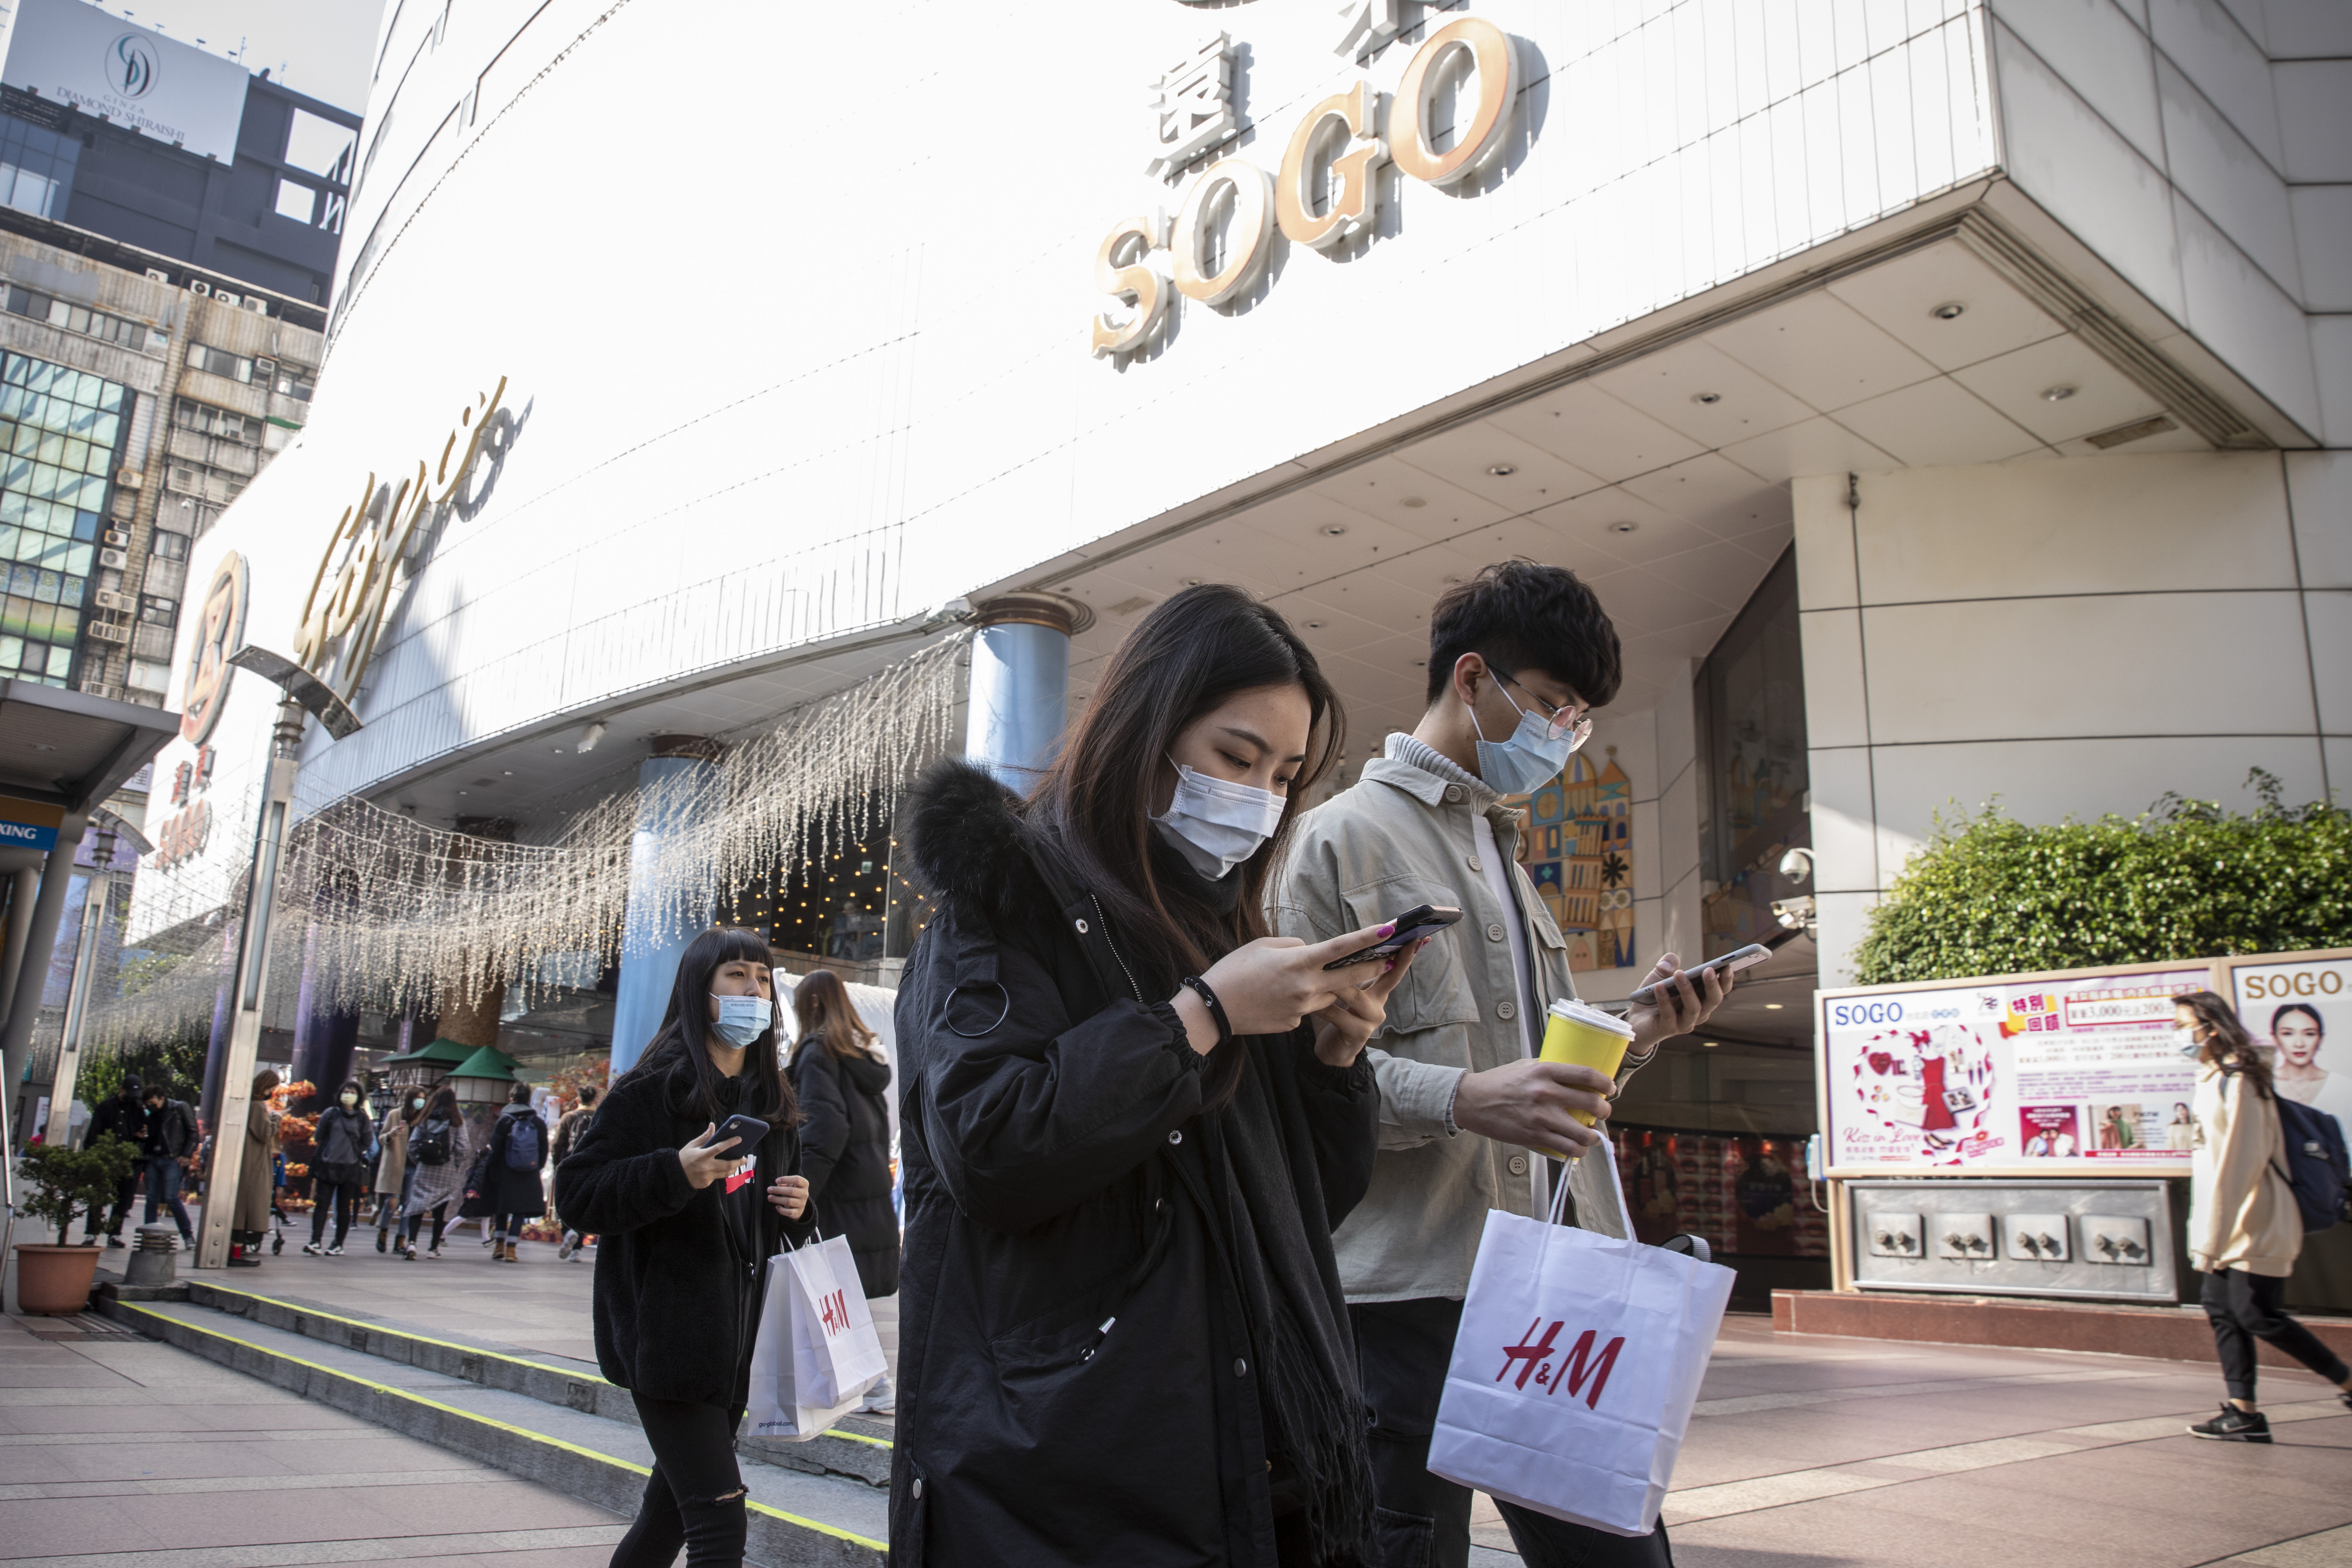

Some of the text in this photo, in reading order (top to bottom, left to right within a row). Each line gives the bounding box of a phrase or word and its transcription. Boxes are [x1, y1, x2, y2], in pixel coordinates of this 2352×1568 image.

[57, 86, 185, 141] DIAMOND SHIRAISHI
[103, 94, 145, 115] GINZA
[1092, 18, 1519, 359] SOGO
[2245, 971, 2342, 999] SOGO
[1835, 1002, 1903, 1026] SOGO
[2012, 993, 2045, 1013] 特別
[1889, 1128, 1920, 1143] Love
[819, 1288, 850, 1337] H&M
[1496, 1317, 1625, 1410] H&M
